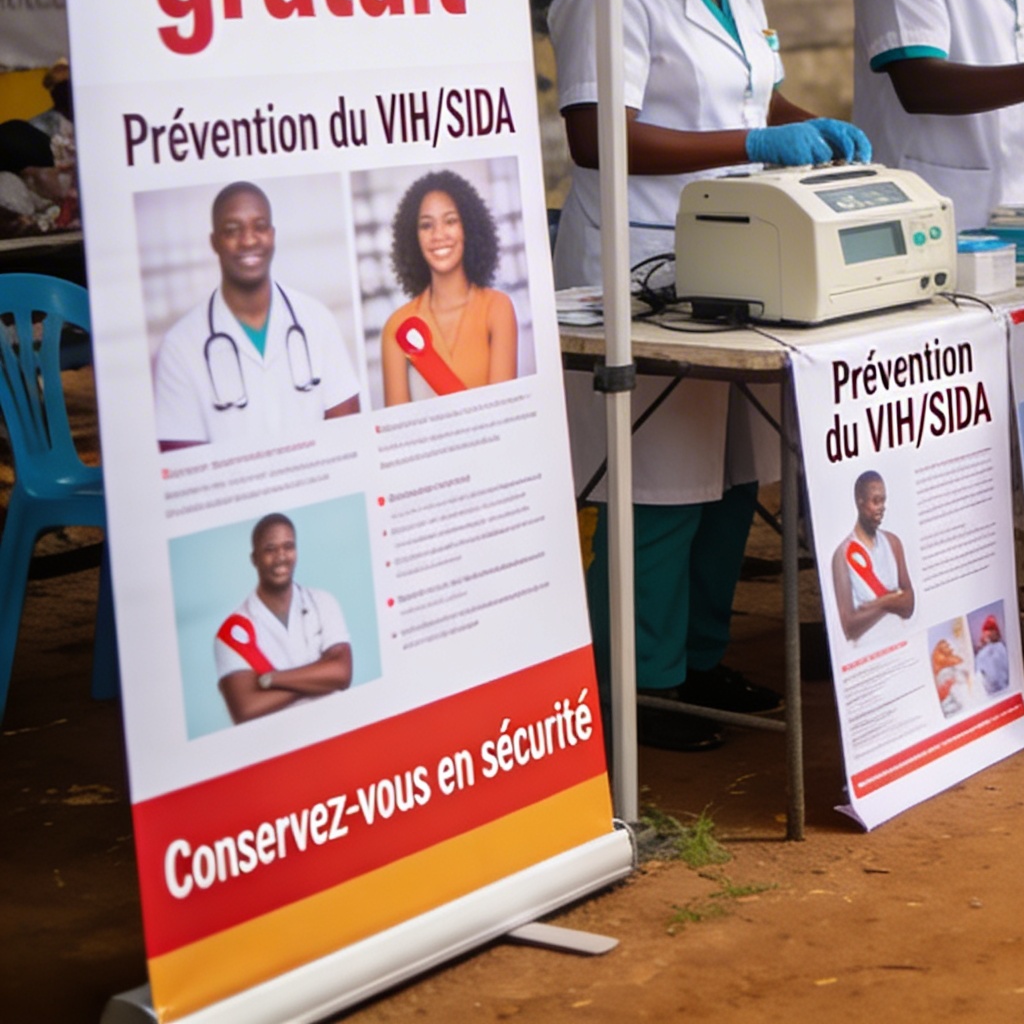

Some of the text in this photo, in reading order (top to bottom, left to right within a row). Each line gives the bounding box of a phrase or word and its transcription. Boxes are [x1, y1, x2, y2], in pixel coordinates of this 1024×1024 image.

[122, 86, 516, 166] Prévention du VIH/SIDA
[832, 338, 973, 404] Prévention
[825, 381, 992, 463] du VIH/SIDA
[163, 687, 593, 899] Conservez-vous en sécurité
